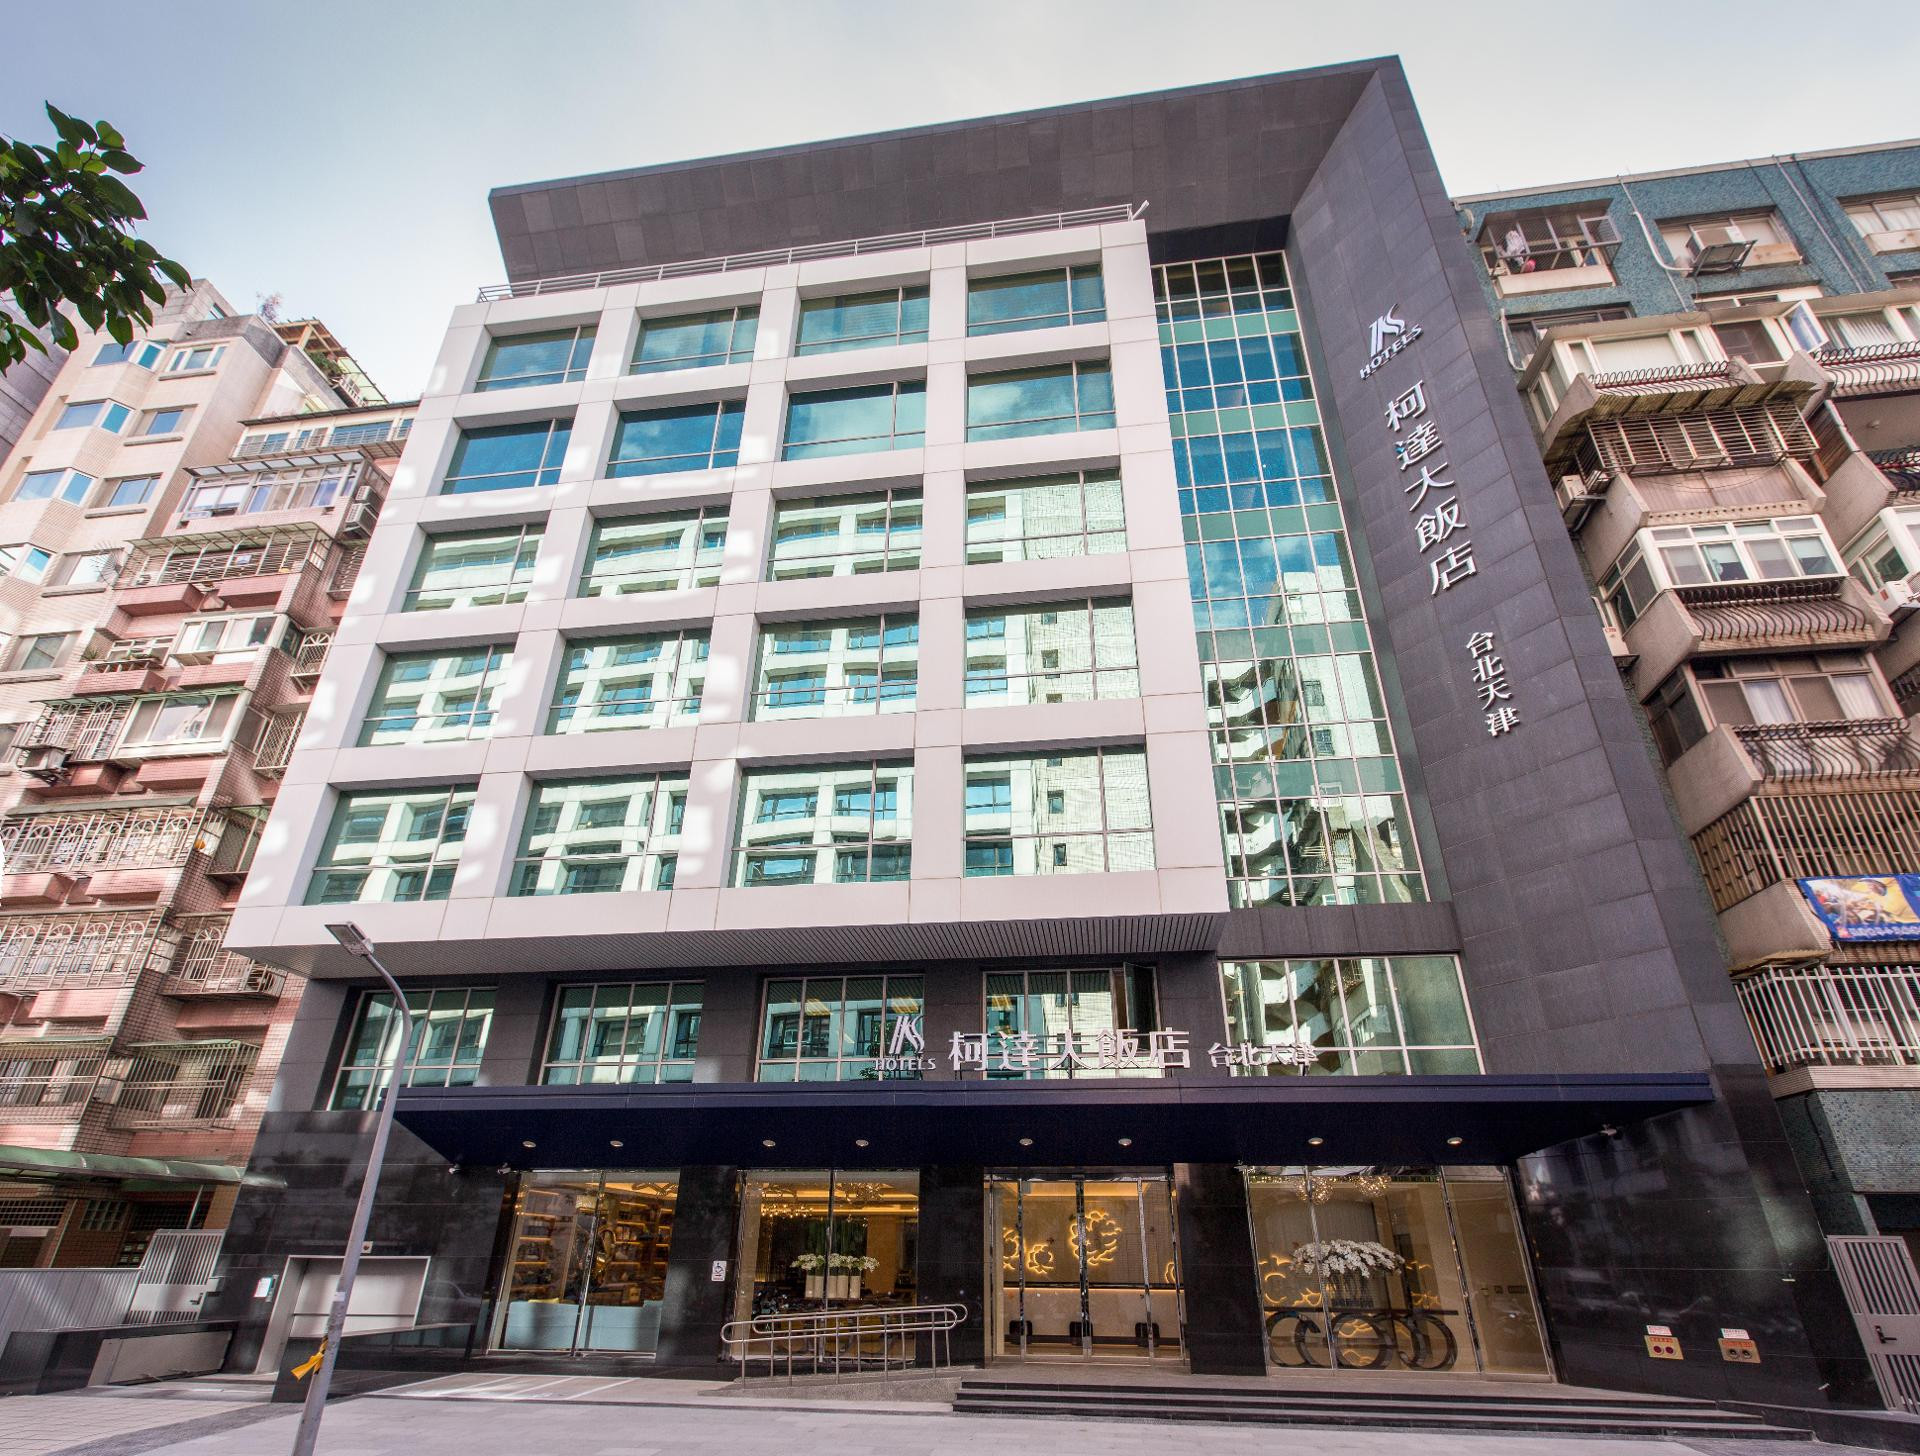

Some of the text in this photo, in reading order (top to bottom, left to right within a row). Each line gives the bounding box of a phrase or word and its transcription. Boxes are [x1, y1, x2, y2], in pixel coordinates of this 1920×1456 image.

[1359, 323, 1422, 379] HOTELS
[1384, 379, 1478, 596] 柯達大飯店
[1466, 632, 1520, 737] 台北天津
[875, 1058, 937, 1071] HOTELS
[948, 1027, 1190, 1071] 柯達大飯店
[1207, 1042, 1319, 1068] 台北天津
